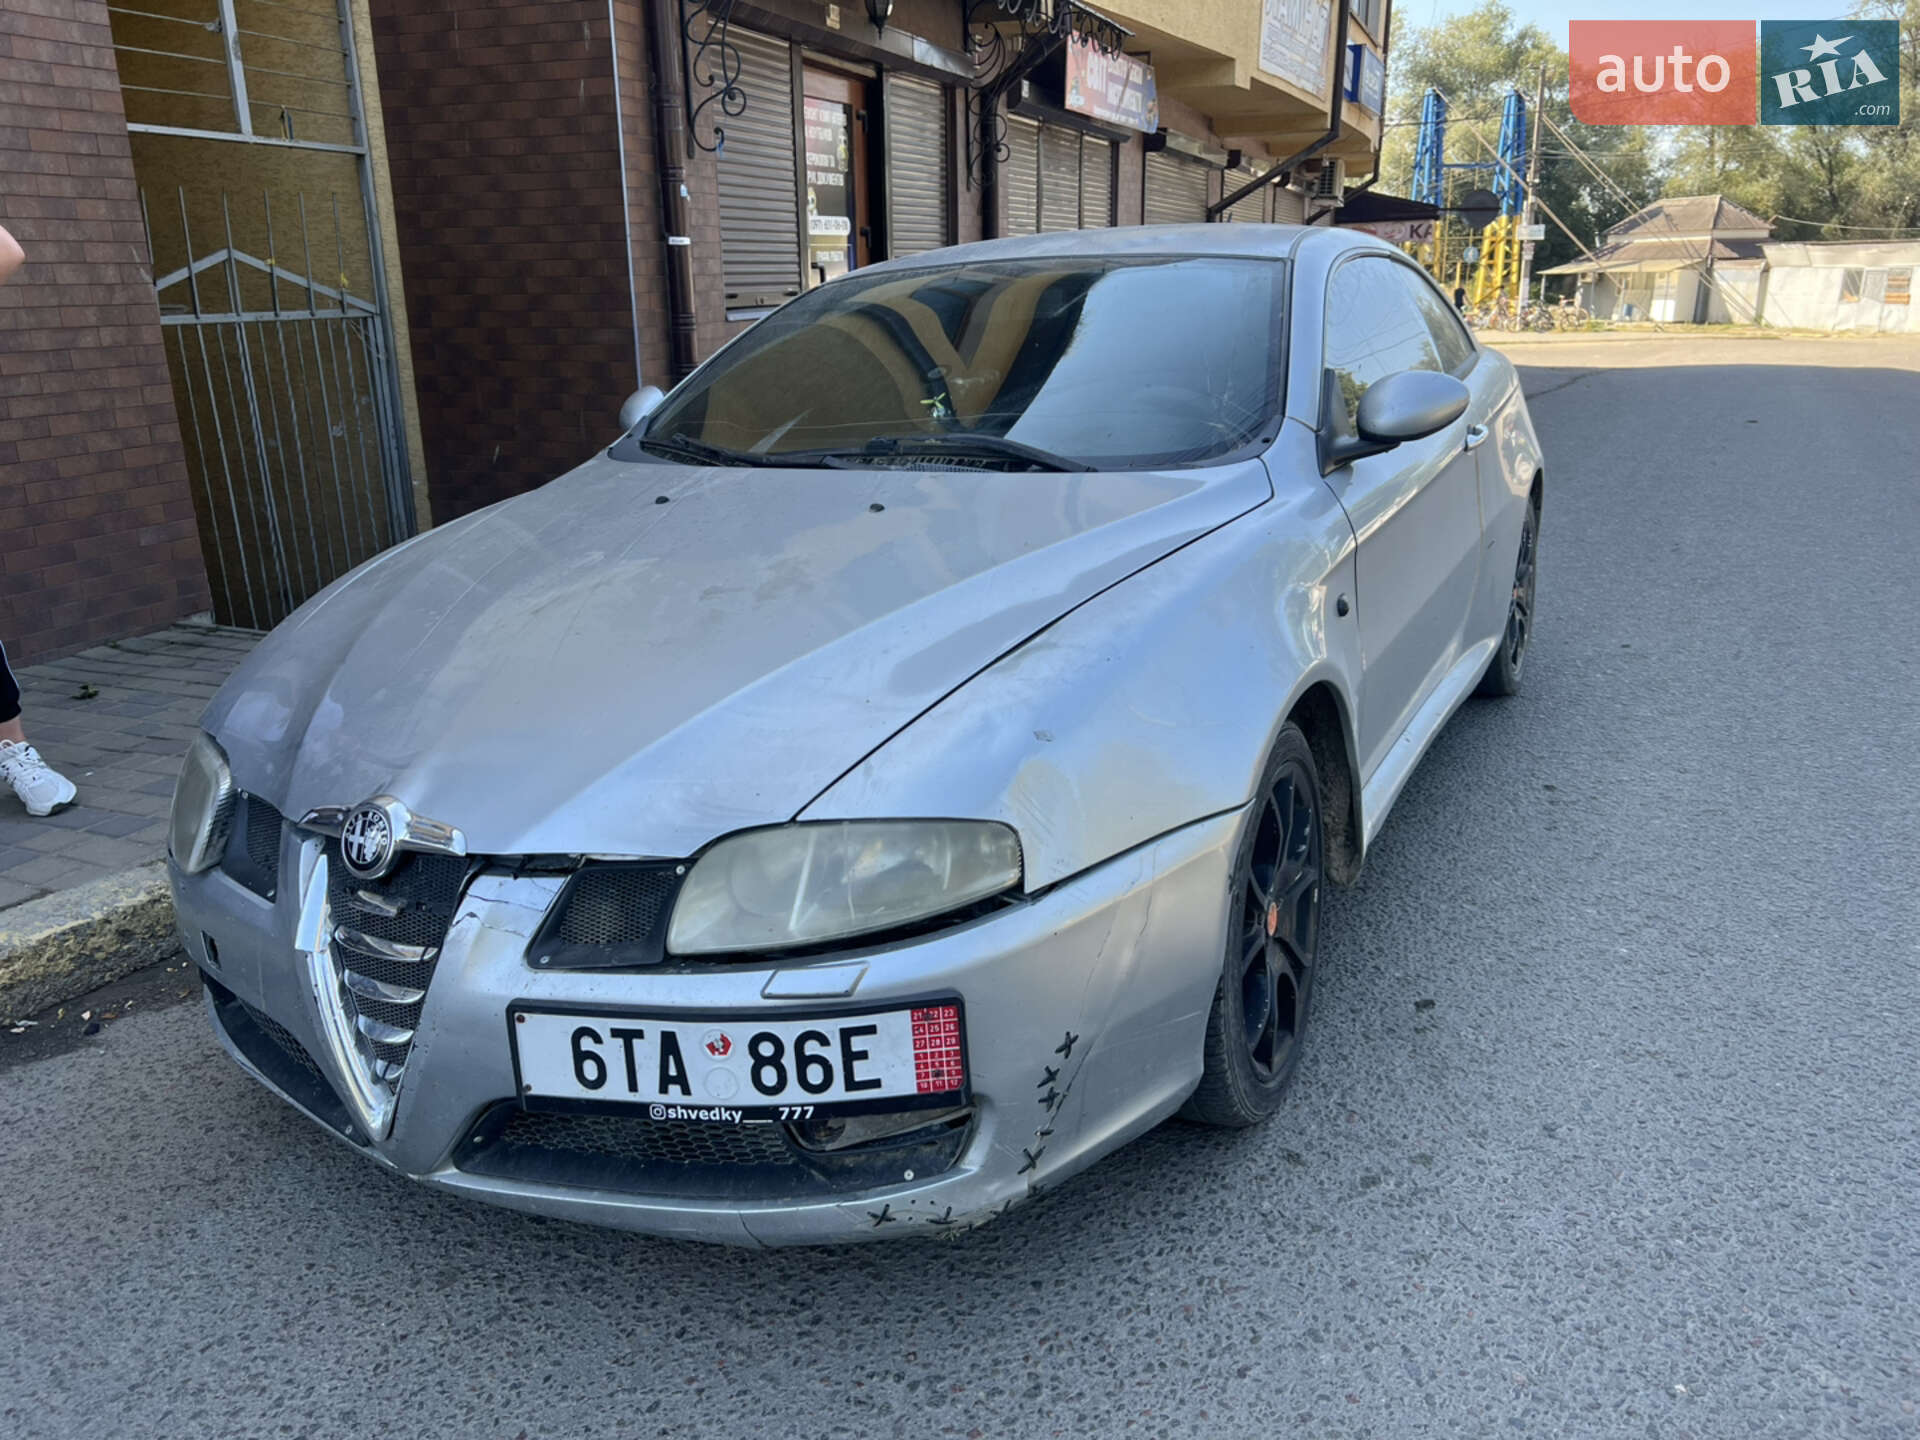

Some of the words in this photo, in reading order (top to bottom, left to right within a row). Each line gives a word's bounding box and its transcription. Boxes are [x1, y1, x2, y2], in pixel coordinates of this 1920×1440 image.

[944, 1009, 954, 1017] 23
[570, 1025, 693, 1097] 6TA
[747, 1023, 883, 1097] 86E
